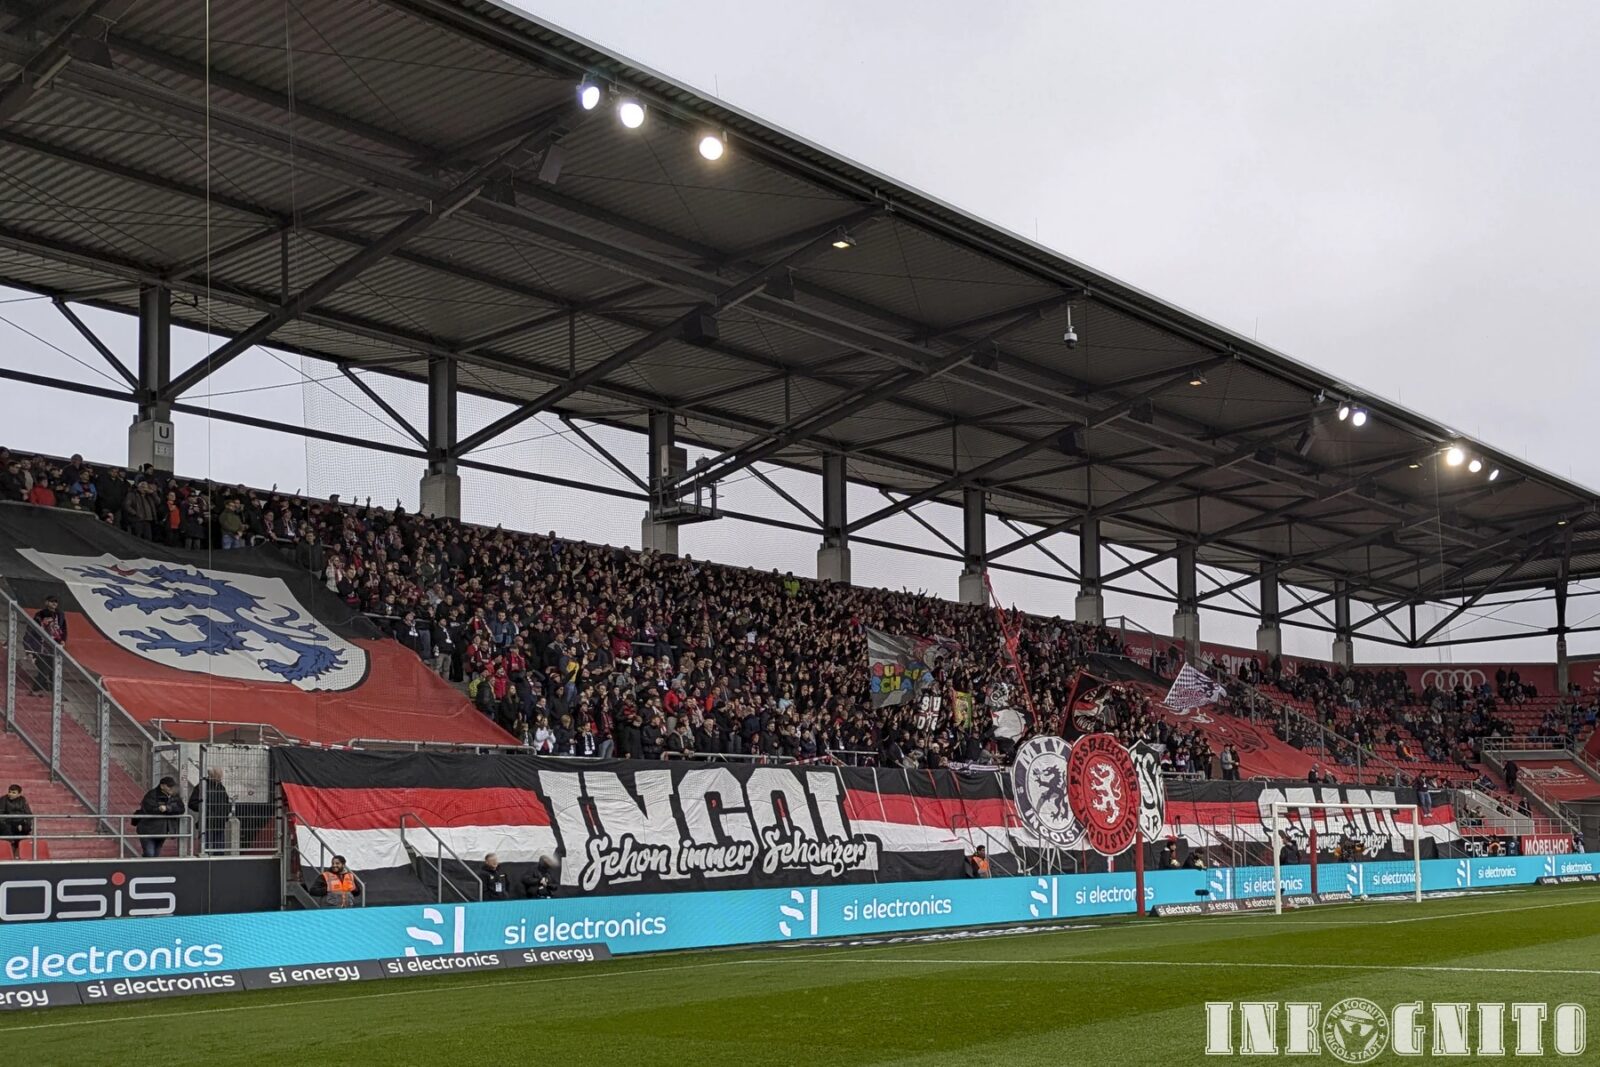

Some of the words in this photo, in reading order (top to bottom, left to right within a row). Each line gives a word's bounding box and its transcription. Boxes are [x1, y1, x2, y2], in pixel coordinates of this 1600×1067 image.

[159, 425, 170, 439] U
[1018, 738, 1066, 769] MTV
[583, 836, 671, 891] Schon
[679, 838, 754, 872] immer
[762, 826, 868, 877] Schanzer
[1373, 870, 1381, 885] si
[1485, 865, 1517, 879] electronics
[1243, 877, 1252, 893] si
[1253, 875, 1303, 892] electonics
[1075, 888, 1087, 905] si
[843, 902, 858, 921] si
[862, 896, 952, 920] electronics
[1166, 903, 1202, 914] electronics
[504, 918, 527, 945] si
[533, 911, 667, 943] electronics
[5, 938, 224, 980] electronics
[387, 957, 405, 974] si
[406, 951, 500, 973] electronics
[522, 948, 539, 963] si
[540, 947, 595, 962] energy
[268, 967, 288, 984] si
[291, 965, 361, 982] energy
[87, 981, 107, 998] si
[113, 972, 236, 996] electronics
